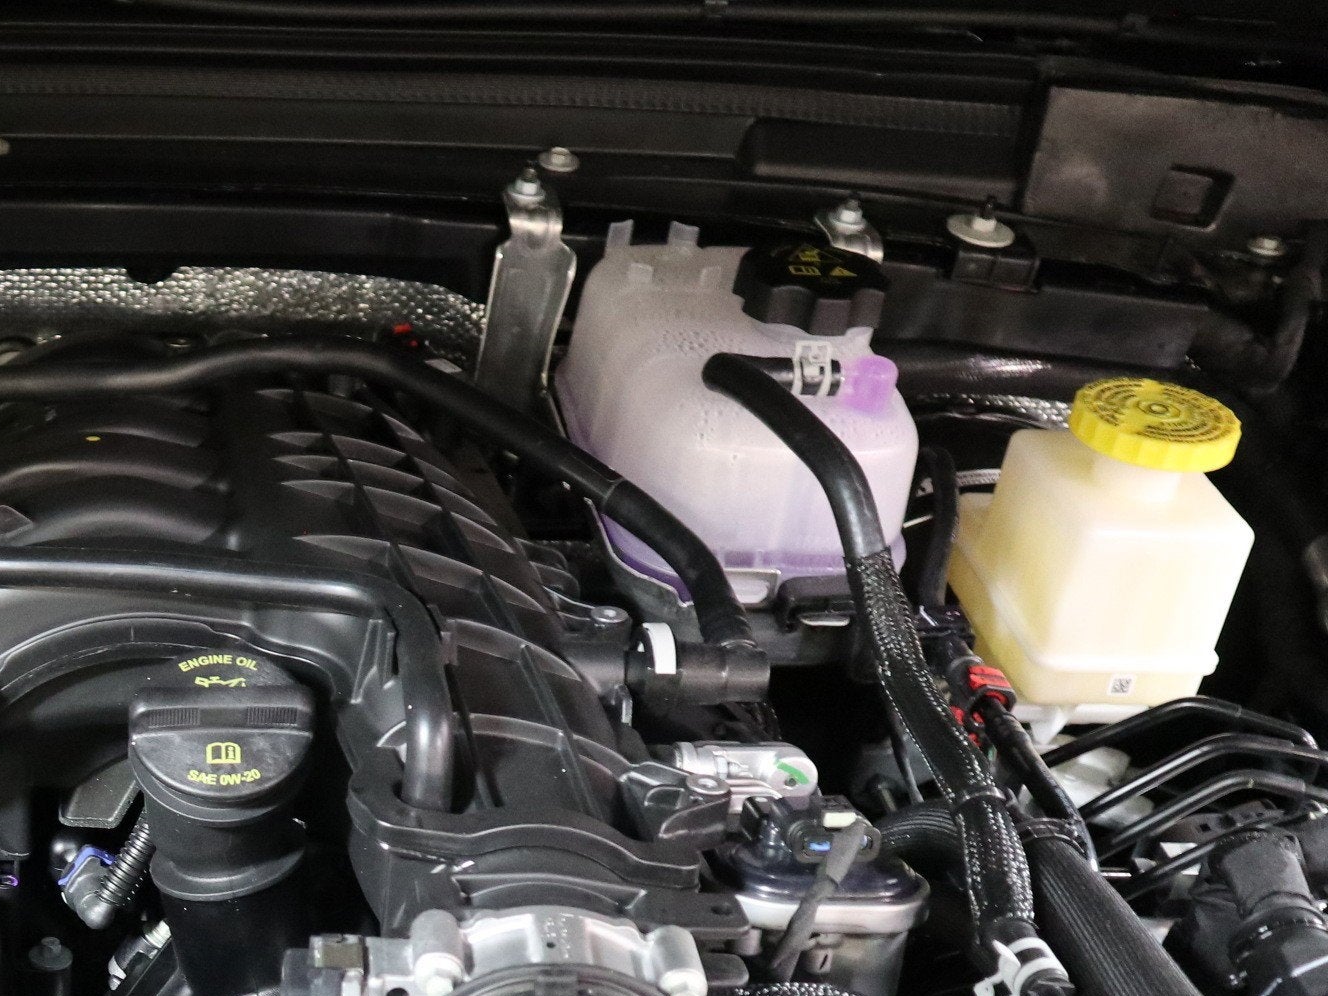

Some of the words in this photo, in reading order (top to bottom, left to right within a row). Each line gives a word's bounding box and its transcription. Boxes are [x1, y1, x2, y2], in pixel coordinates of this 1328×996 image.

[178, 654, 233, 673] ENGINE
[235, 656, 259, 671] OIL
[187, 768, 217, 786] SAE
[219, 768, 262, 786] 0W-20
